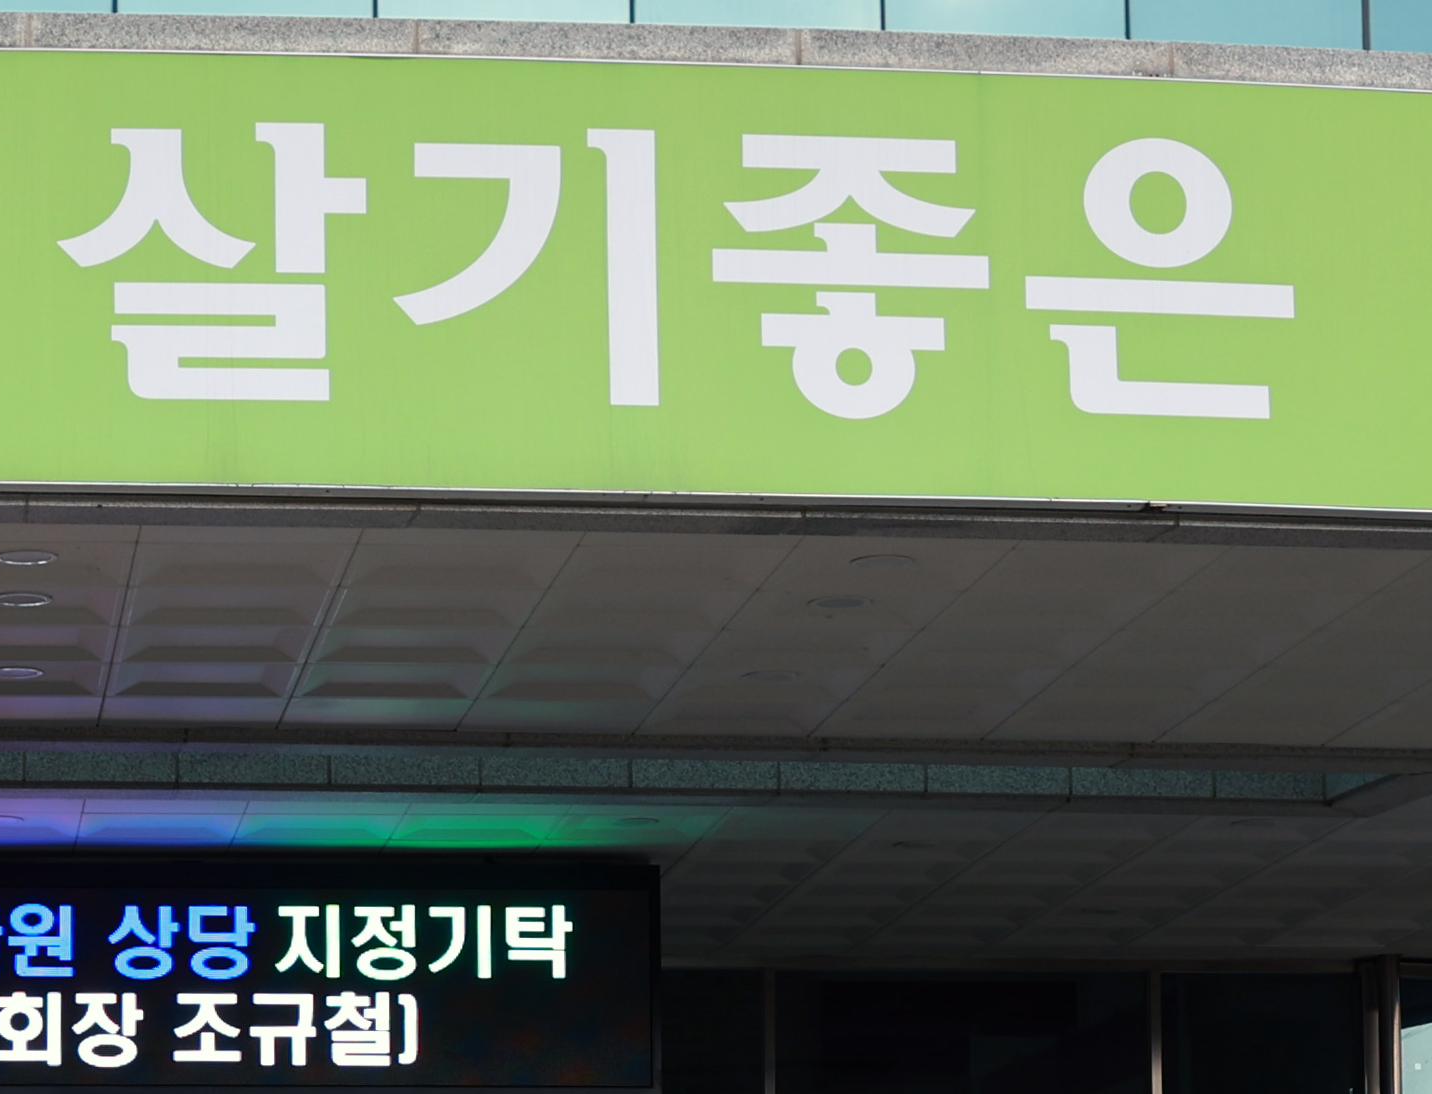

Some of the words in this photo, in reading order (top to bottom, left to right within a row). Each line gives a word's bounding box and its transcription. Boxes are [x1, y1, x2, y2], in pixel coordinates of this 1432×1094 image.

[57, 122, 1297, 421] 살기좋은
[109, 904, 258, 981] 상당
[274, 905, 574, 982] 지정기탁
[173, 992, 420, 1068] 조규철)
